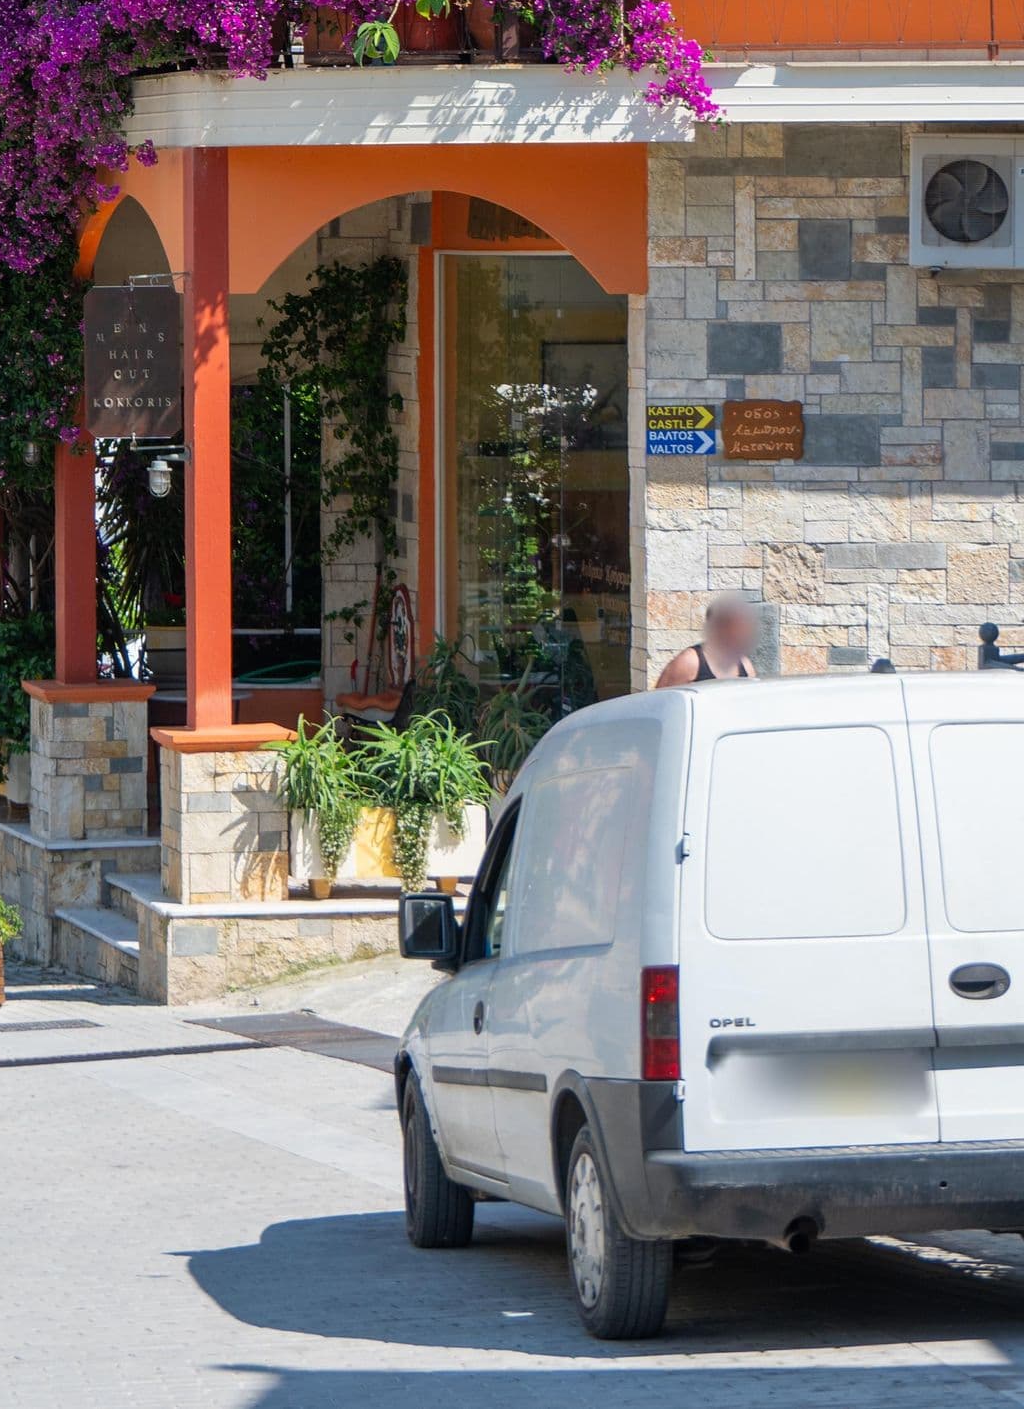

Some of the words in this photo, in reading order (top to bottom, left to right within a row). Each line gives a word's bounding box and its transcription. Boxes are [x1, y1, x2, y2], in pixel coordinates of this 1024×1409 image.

[96, 323, 166, 342] MENS
[108, 349, 154, 360] HAIR
[113, 368, 151, 380] CUT
[92, 396, 172, 409] KOKKORIS
[647, 406, 695, 416] ΚΑΣΤΡΟ
[648, 419, 695, 429] CASTLE
[648, 431, 695, 441] ΒΑΛΤΟΣ
[649, 444, 694, 454] VALTOS
[709, 1017, 756, 1028] OPEL
